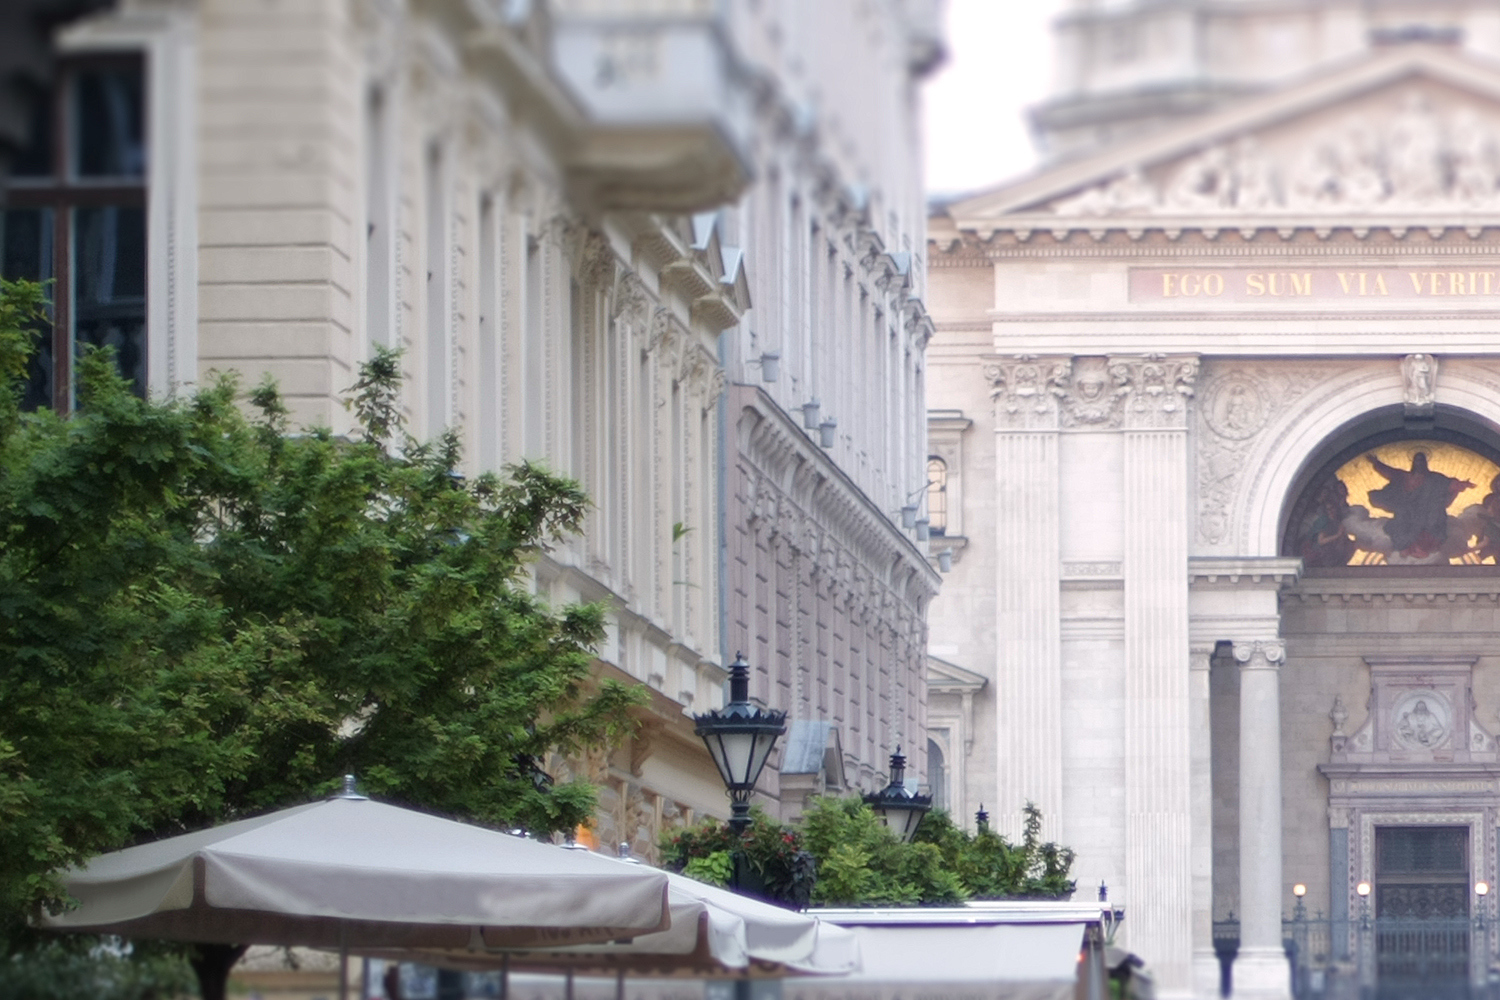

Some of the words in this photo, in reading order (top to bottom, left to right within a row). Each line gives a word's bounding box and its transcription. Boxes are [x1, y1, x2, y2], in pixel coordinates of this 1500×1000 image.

[1162, 272, 1224, 297] EGO
[1245, 272, 1313, 297] SUM
[1336, 272, 1390, 296] VIA
